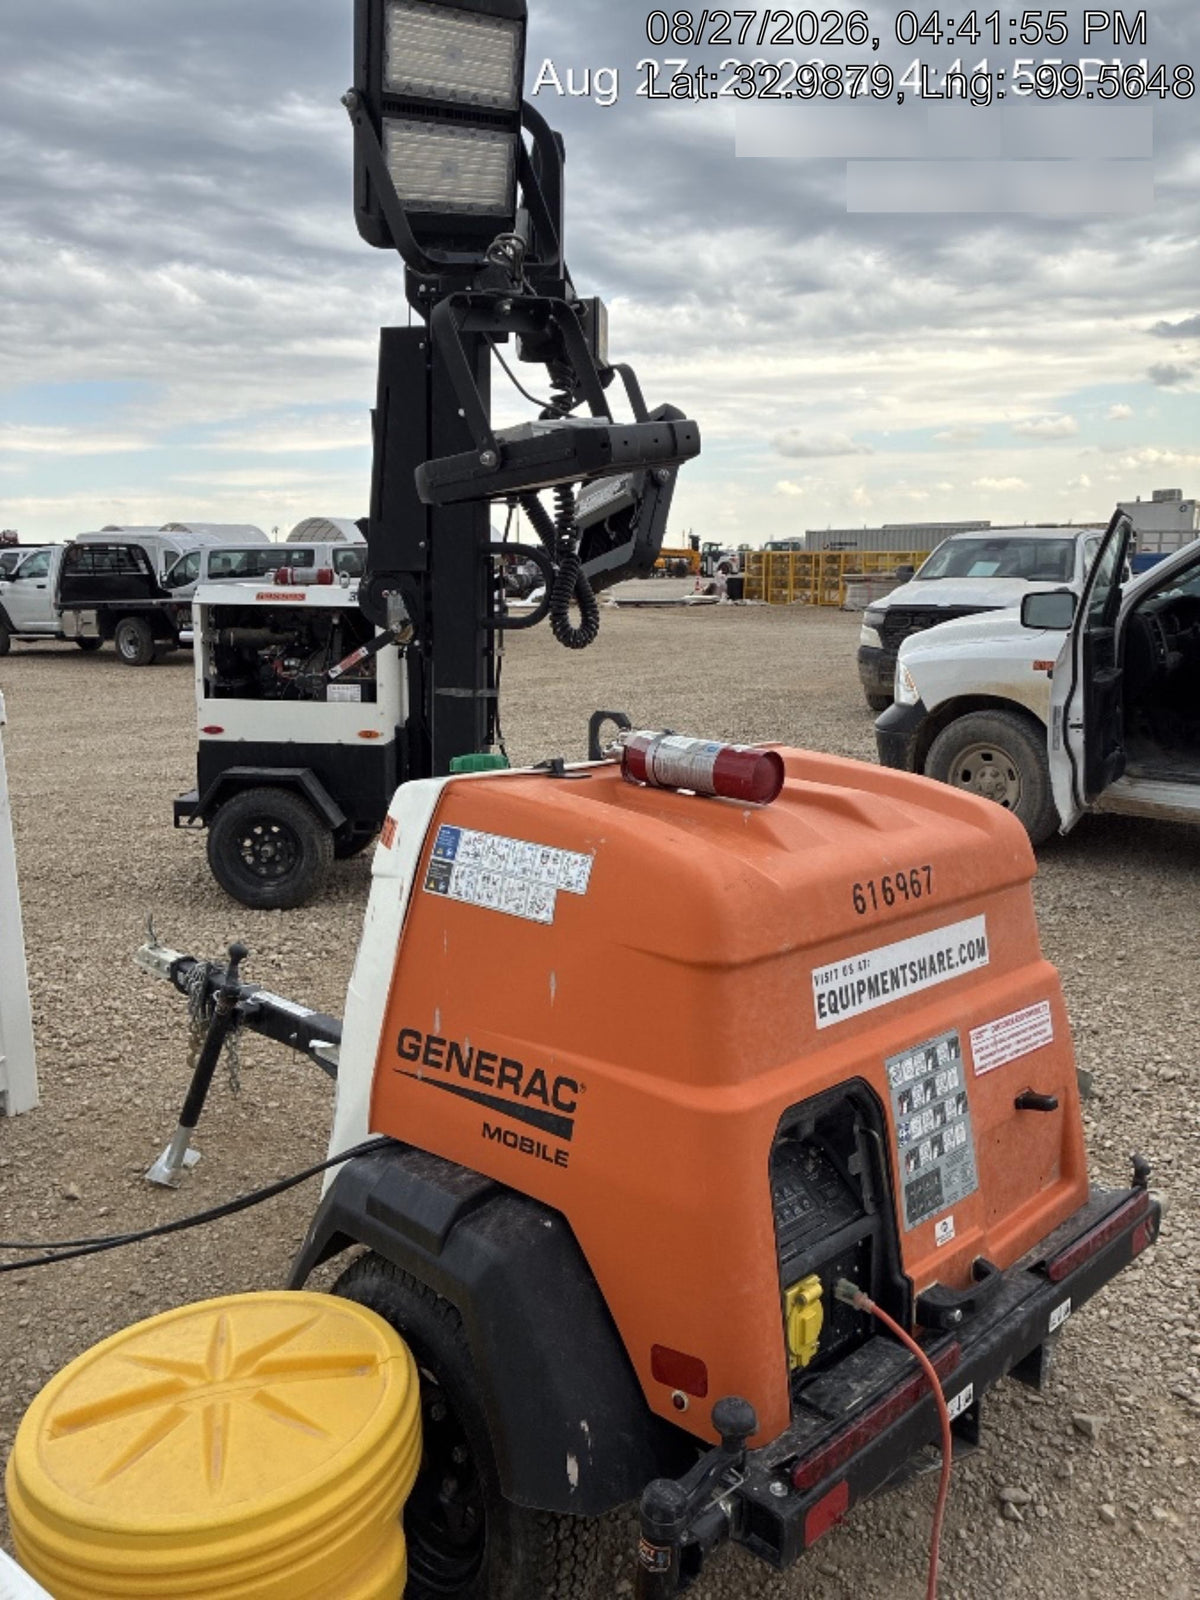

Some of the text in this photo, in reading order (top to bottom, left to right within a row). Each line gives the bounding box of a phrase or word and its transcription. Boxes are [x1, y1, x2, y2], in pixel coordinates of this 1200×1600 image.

[852, 865, 934, 915] 616967
[814, 958, 870, 988] VISIT US AT:
[816, 936, 987, 1020] EQUIPMENTSHARE.COM
[397, 1027, 579, 1114] GENERAC
[482, 1121, 570, 1169] MOBILE
